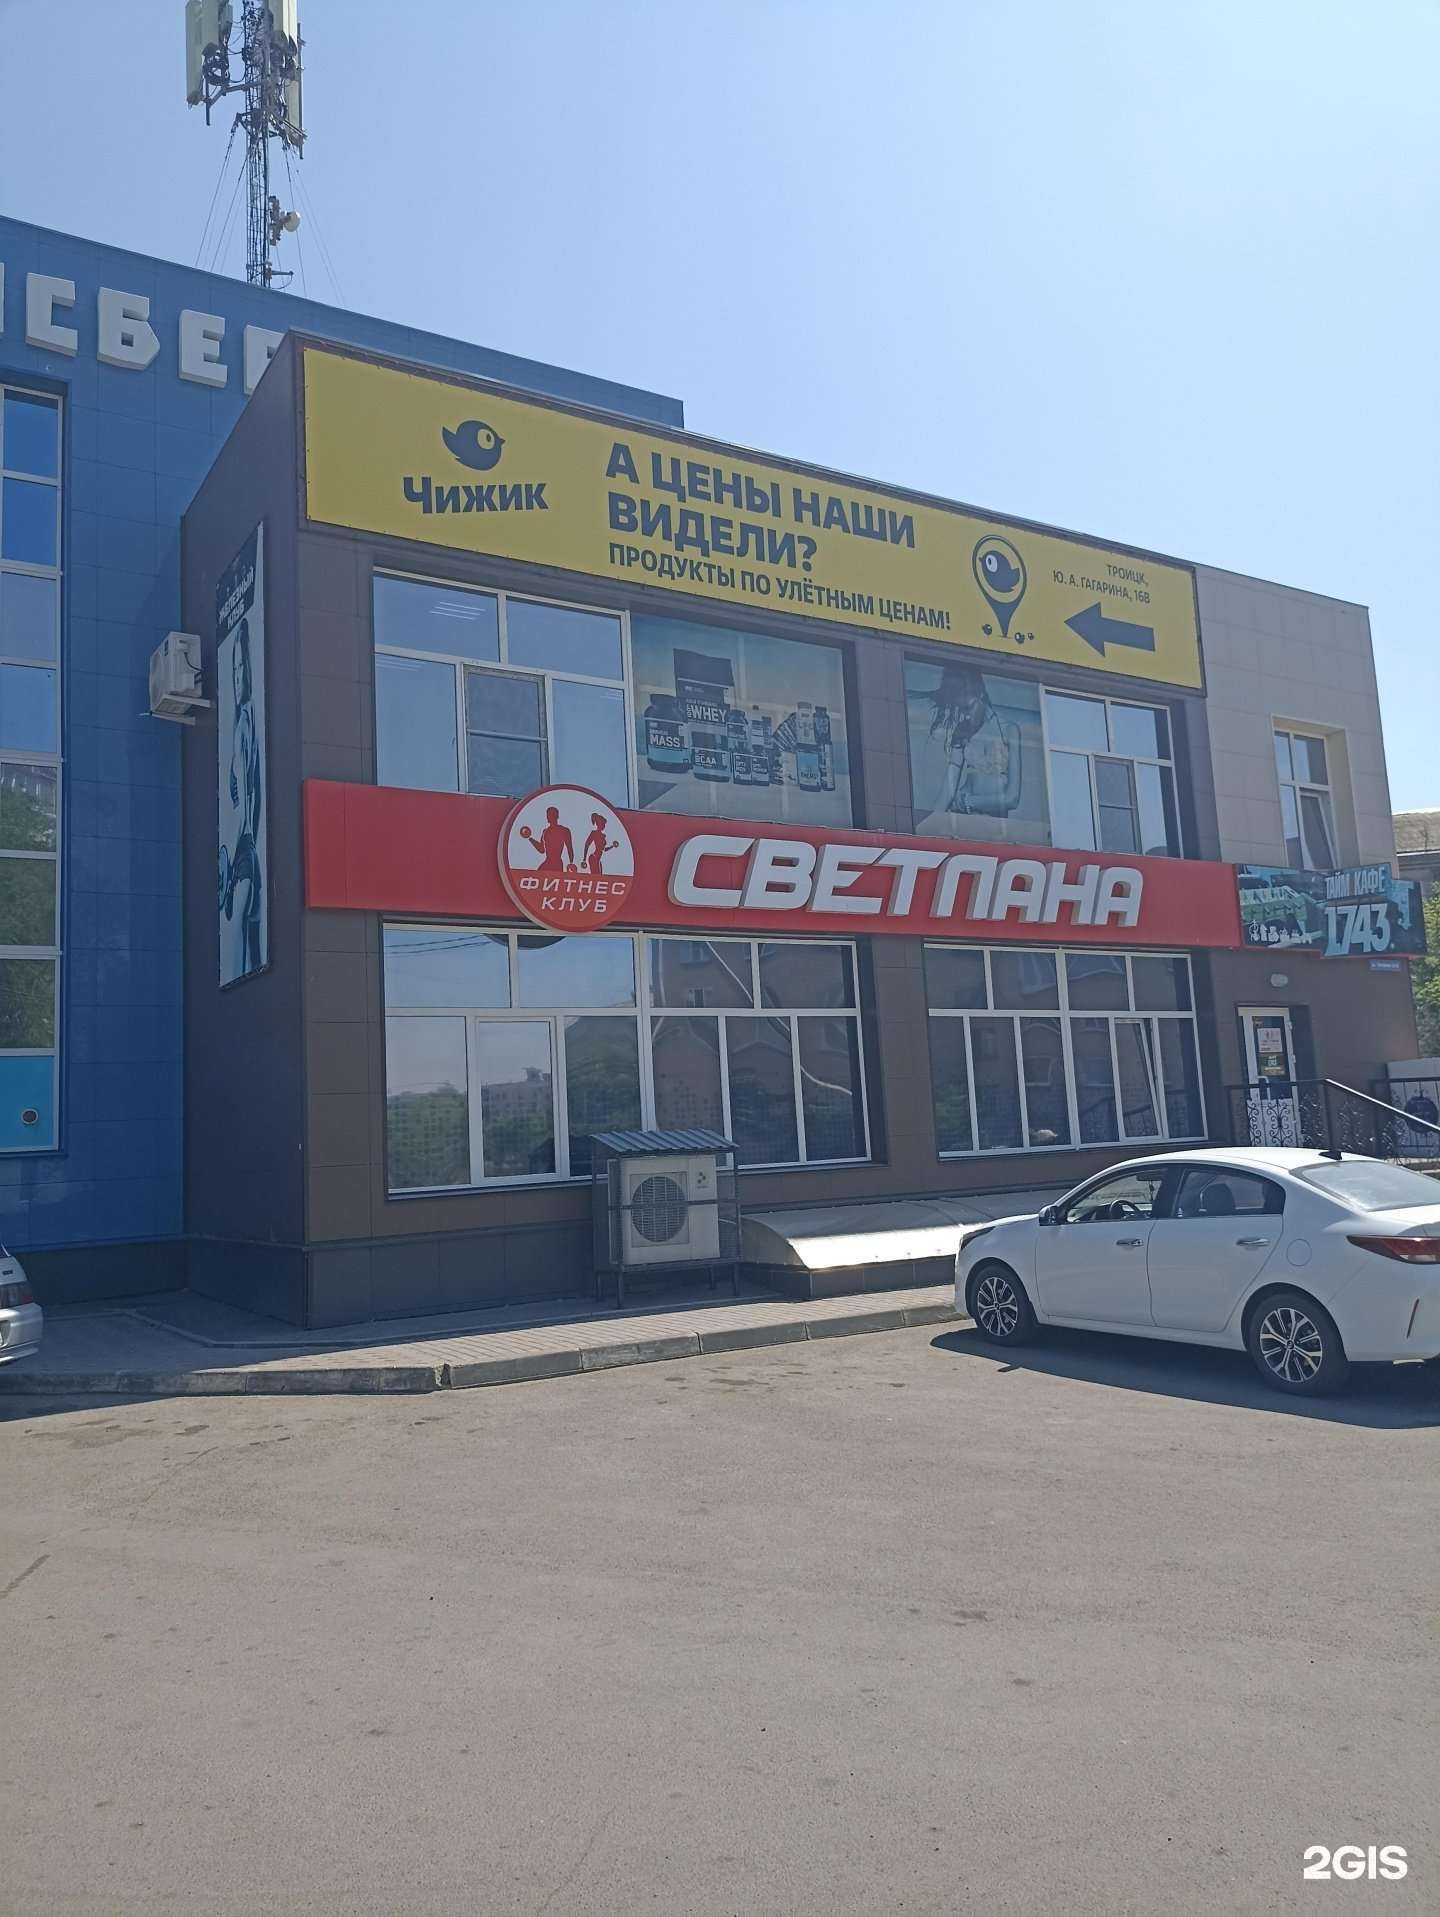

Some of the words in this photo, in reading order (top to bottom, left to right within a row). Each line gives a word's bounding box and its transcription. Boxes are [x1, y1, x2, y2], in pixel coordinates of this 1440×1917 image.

[606, 442, 640, 485] А
[651, 452, 782, 518] ЦЕНЫ
[792, 487, 915, 549] НАШИ
[608, 491, 817, 572] ВИДЕЛИ?
[609, 542, 735, 588] ПРОДУКТЫ
[741, 570, 771, 595] ПО
[776, 577, 874, 615] УЛЁТНЫМ
[879, 598, 951, 630] ЦЕНАМ!
[1080, 576, 1132, 602] ГАГАРИНА,
[692, 703, 727, 723] WHEY
[649, 734, 680, 748] MASS
[519, 876, 626, 896] ФИТНЕС
[667, 834, 1145, 927] СВЕТЛАНА
[1325, 872, 1350, 900] ТАЙМ
[1354, 866, 1385, 895] КАФЕ
[541, 896, 608, 913] КЛУБ
[1325, 903, 1391, 956] 1743
